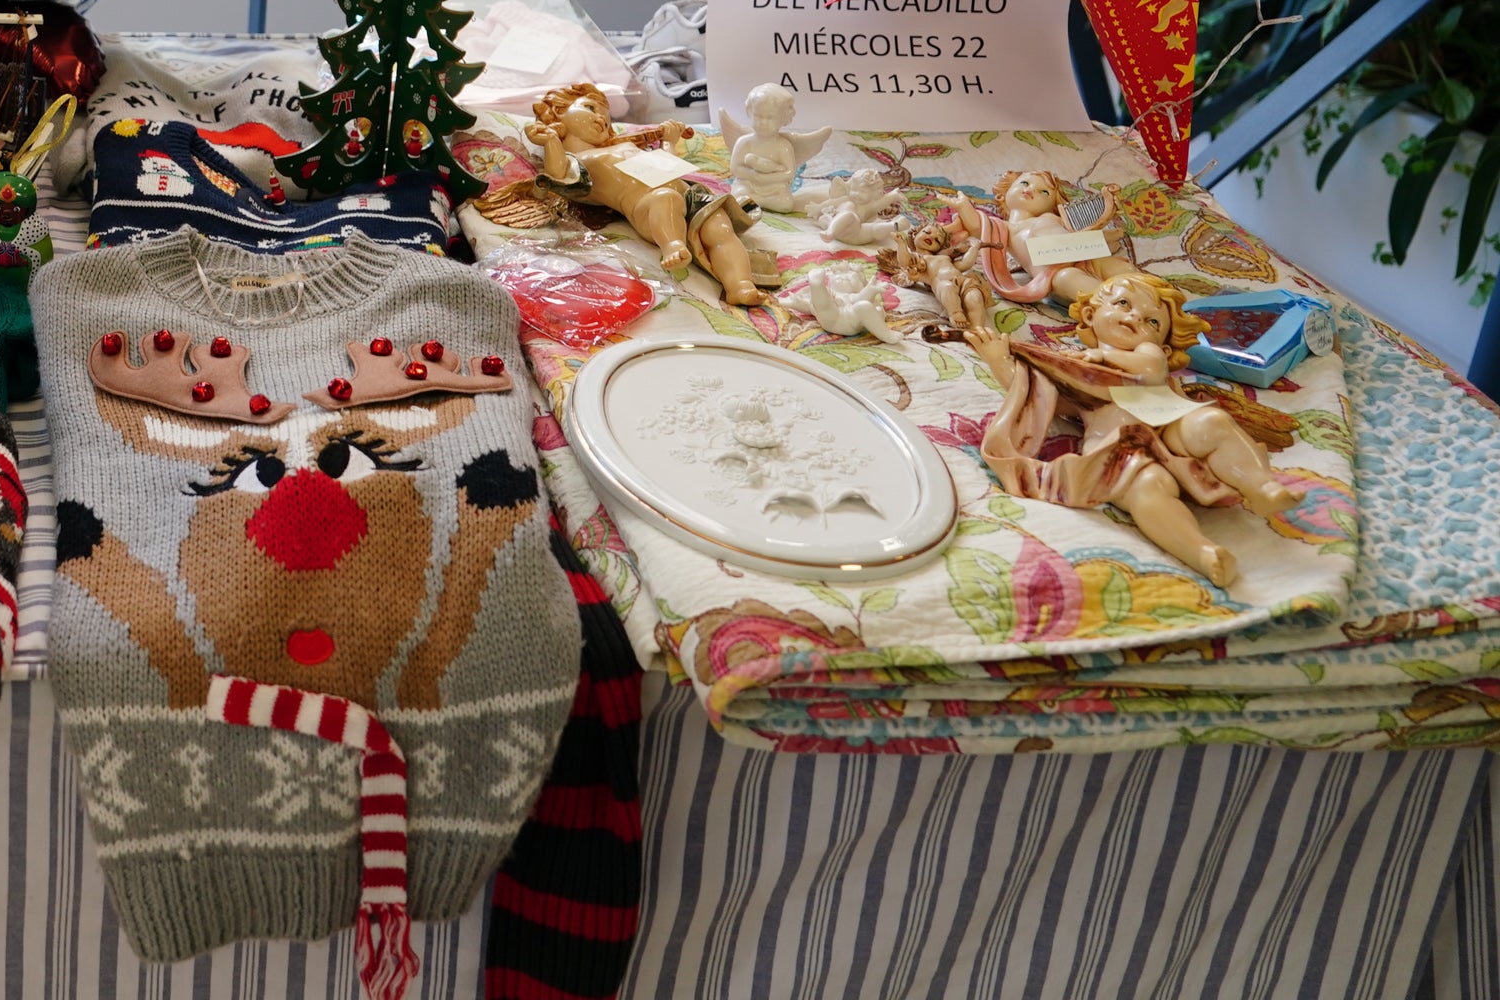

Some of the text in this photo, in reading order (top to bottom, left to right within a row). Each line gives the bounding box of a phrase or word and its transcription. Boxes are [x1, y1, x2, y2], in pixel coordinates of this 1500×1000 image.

[774, 26, 987, 58] MIÉRCOLES 22
[780, 72, 993, 97] A LAS 11,30 H.
